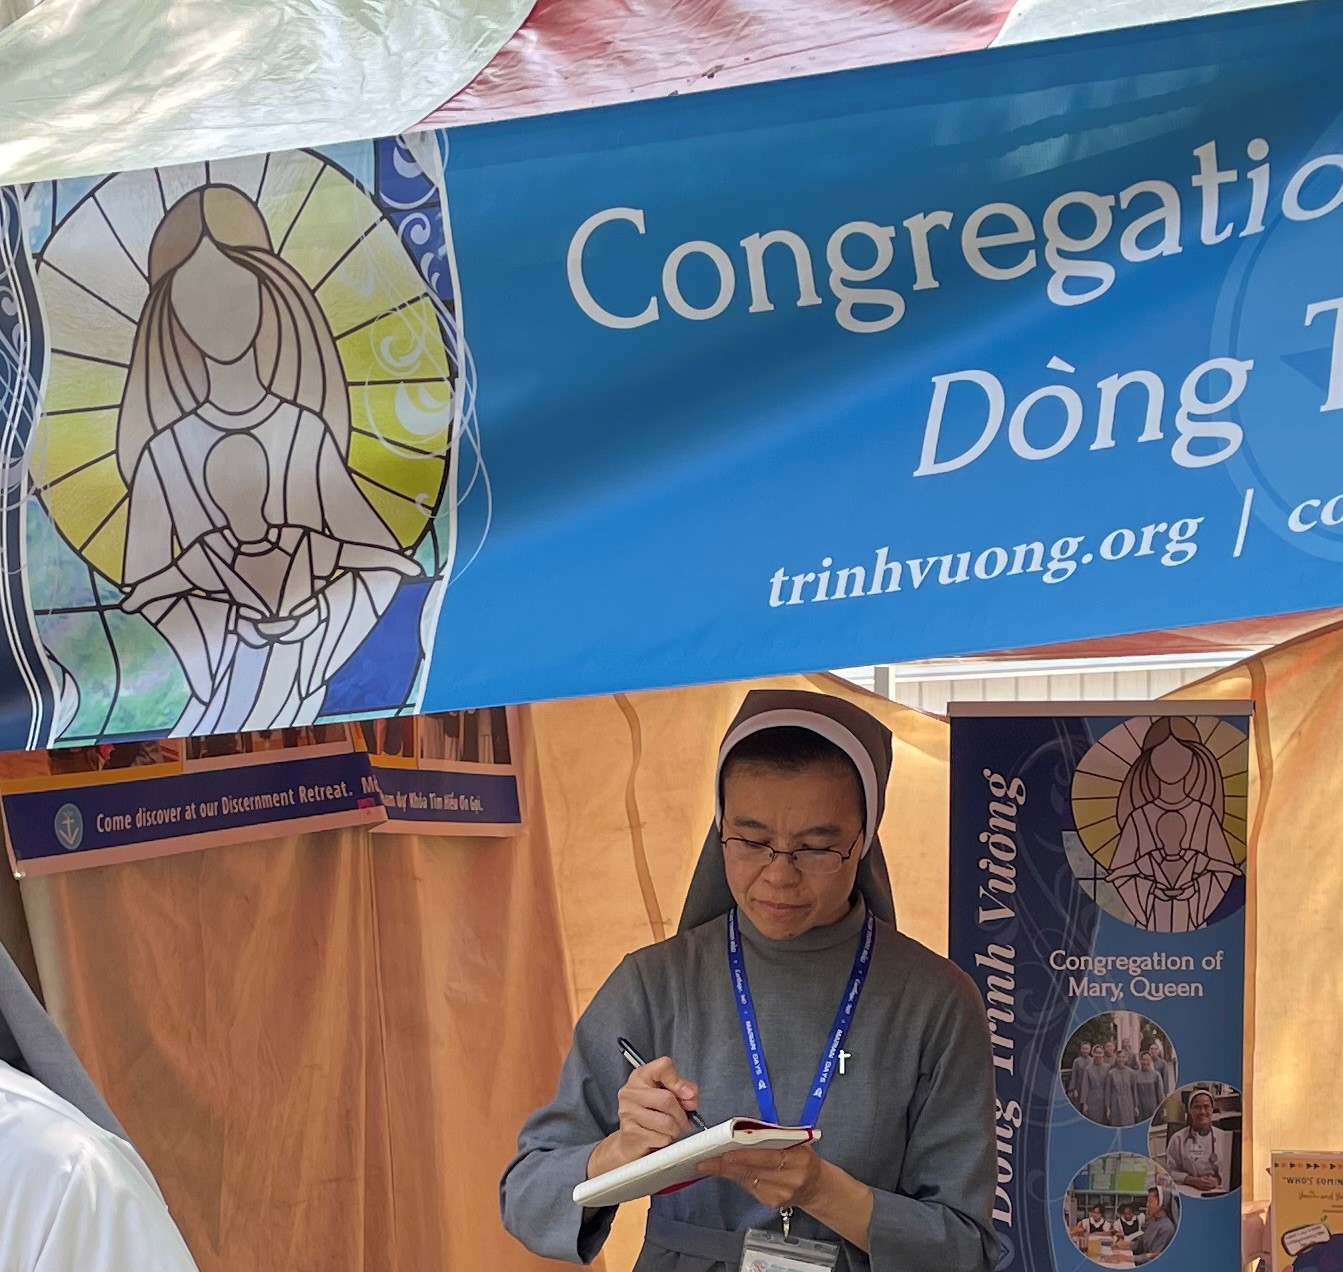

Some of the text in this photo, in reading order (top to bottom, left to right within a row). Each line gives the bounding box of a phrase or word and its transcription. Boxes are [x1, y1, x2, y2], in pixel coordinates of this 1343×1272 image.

[912, 356, 1251, 478] Dòng
[768, 513, 1203, 608] trinhvuong.org
[97, 813, 131, 832] Come
[136, 807, 181, 828] discover
[185, 803, 196, 818] at
[200, 800, 218, 817] our
[221, 788, 294, 814] Discernment
[299, 780, 354, 803] Retreat.
[1049, 950, 1224, 976] Congregation of
[1068, 976, 1204, 1002] Mary, Queen
